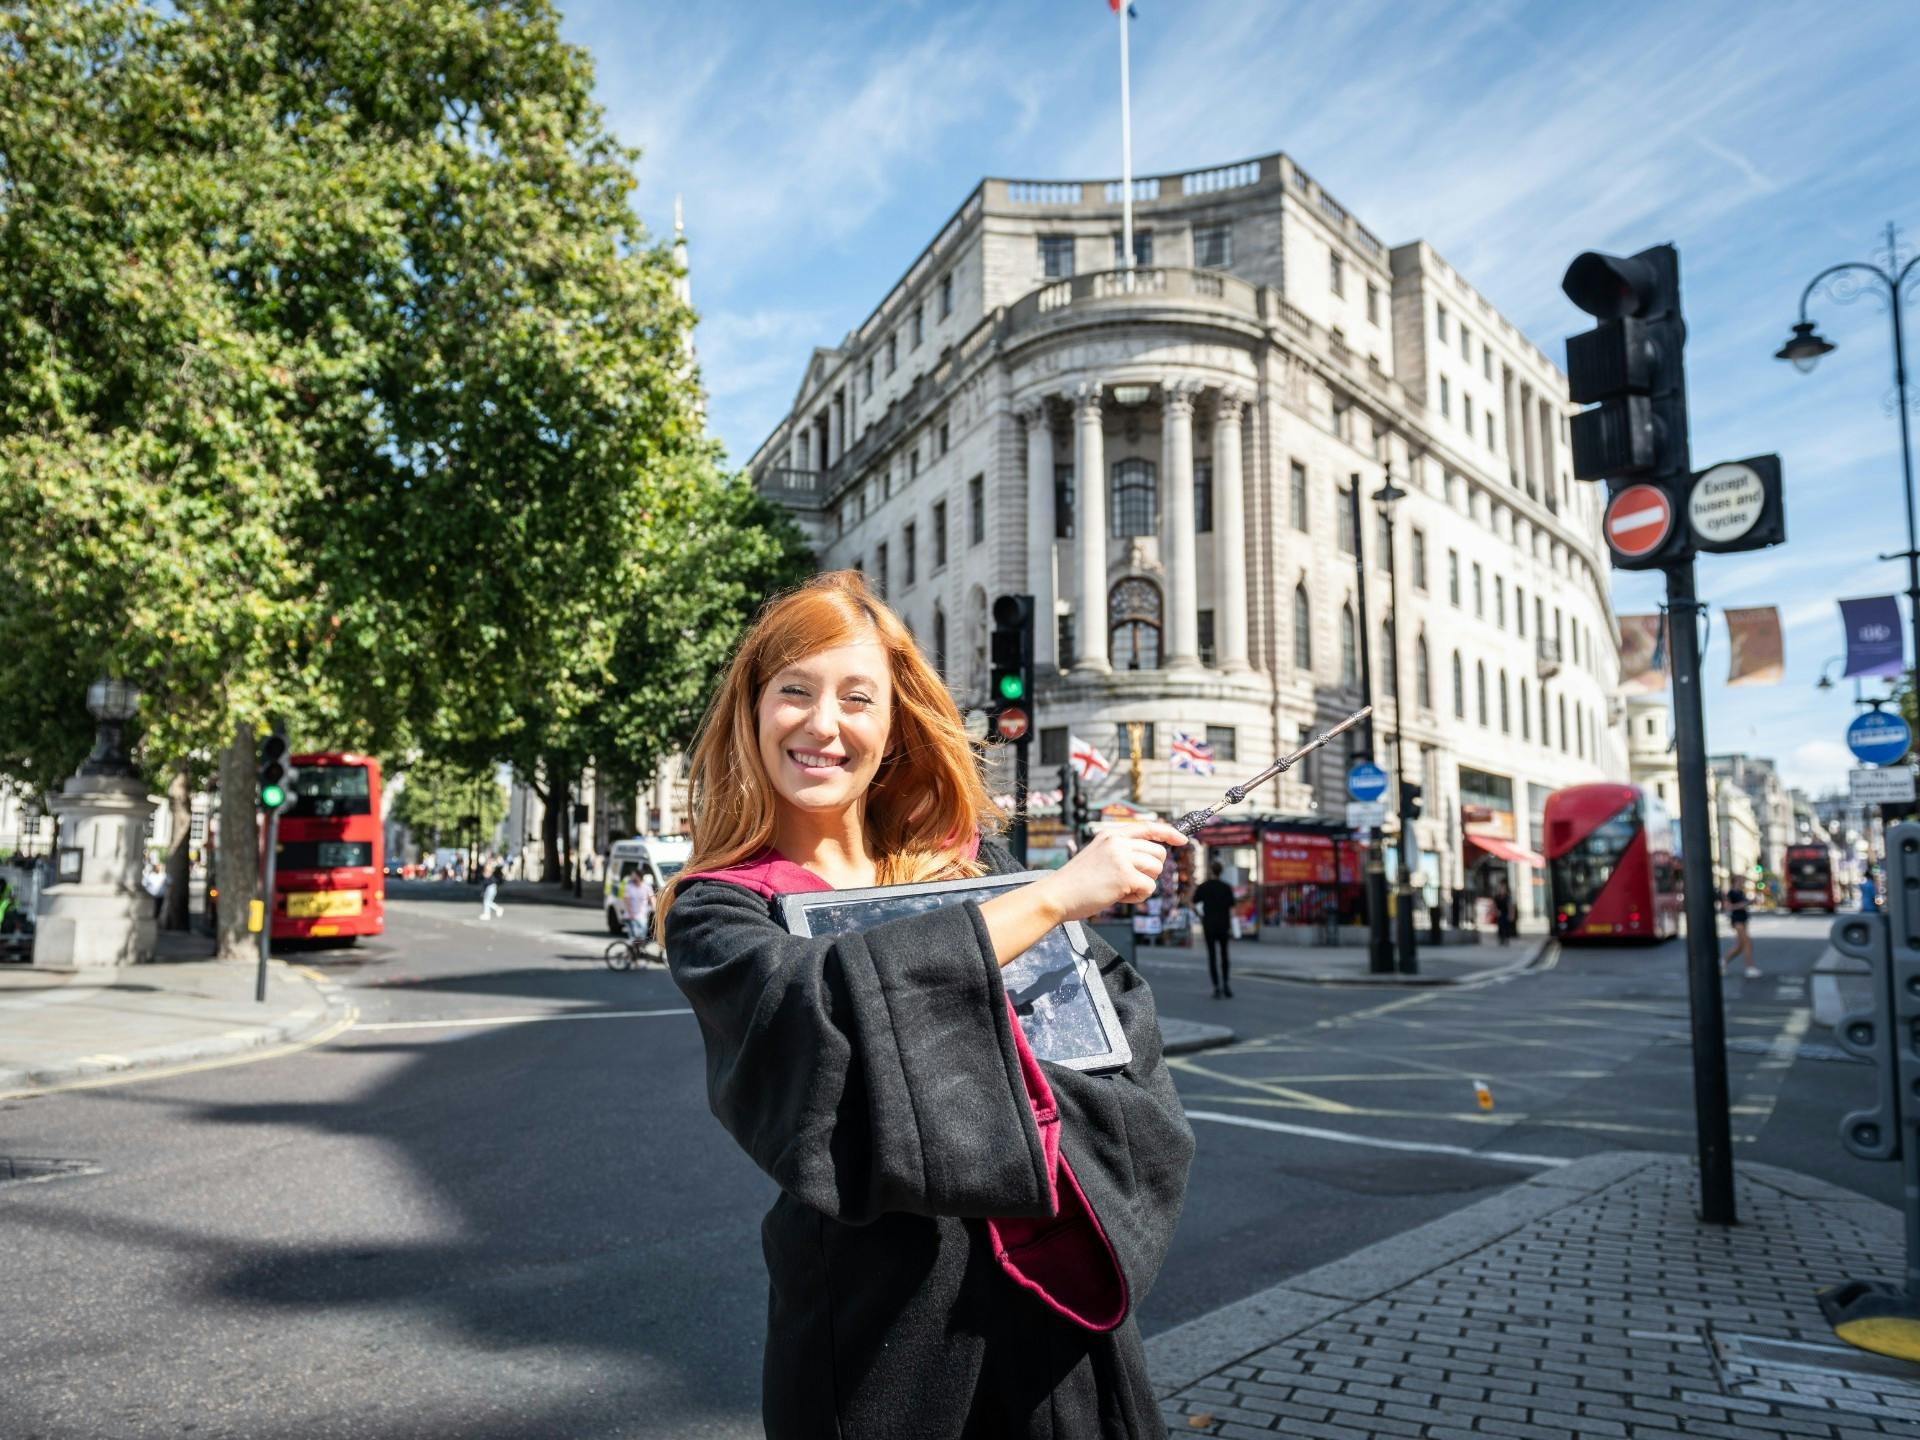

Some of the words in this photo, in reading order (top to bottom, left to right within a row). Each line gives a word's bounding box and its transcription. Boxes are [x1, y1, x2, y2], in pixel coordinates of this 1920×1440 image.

[1704, 475, 1748, 496] Except
[1694, 498, 1731, 515] buses
[1736, 489, 1761, 506] and
[1707, 513, 1747, 532] cycles
